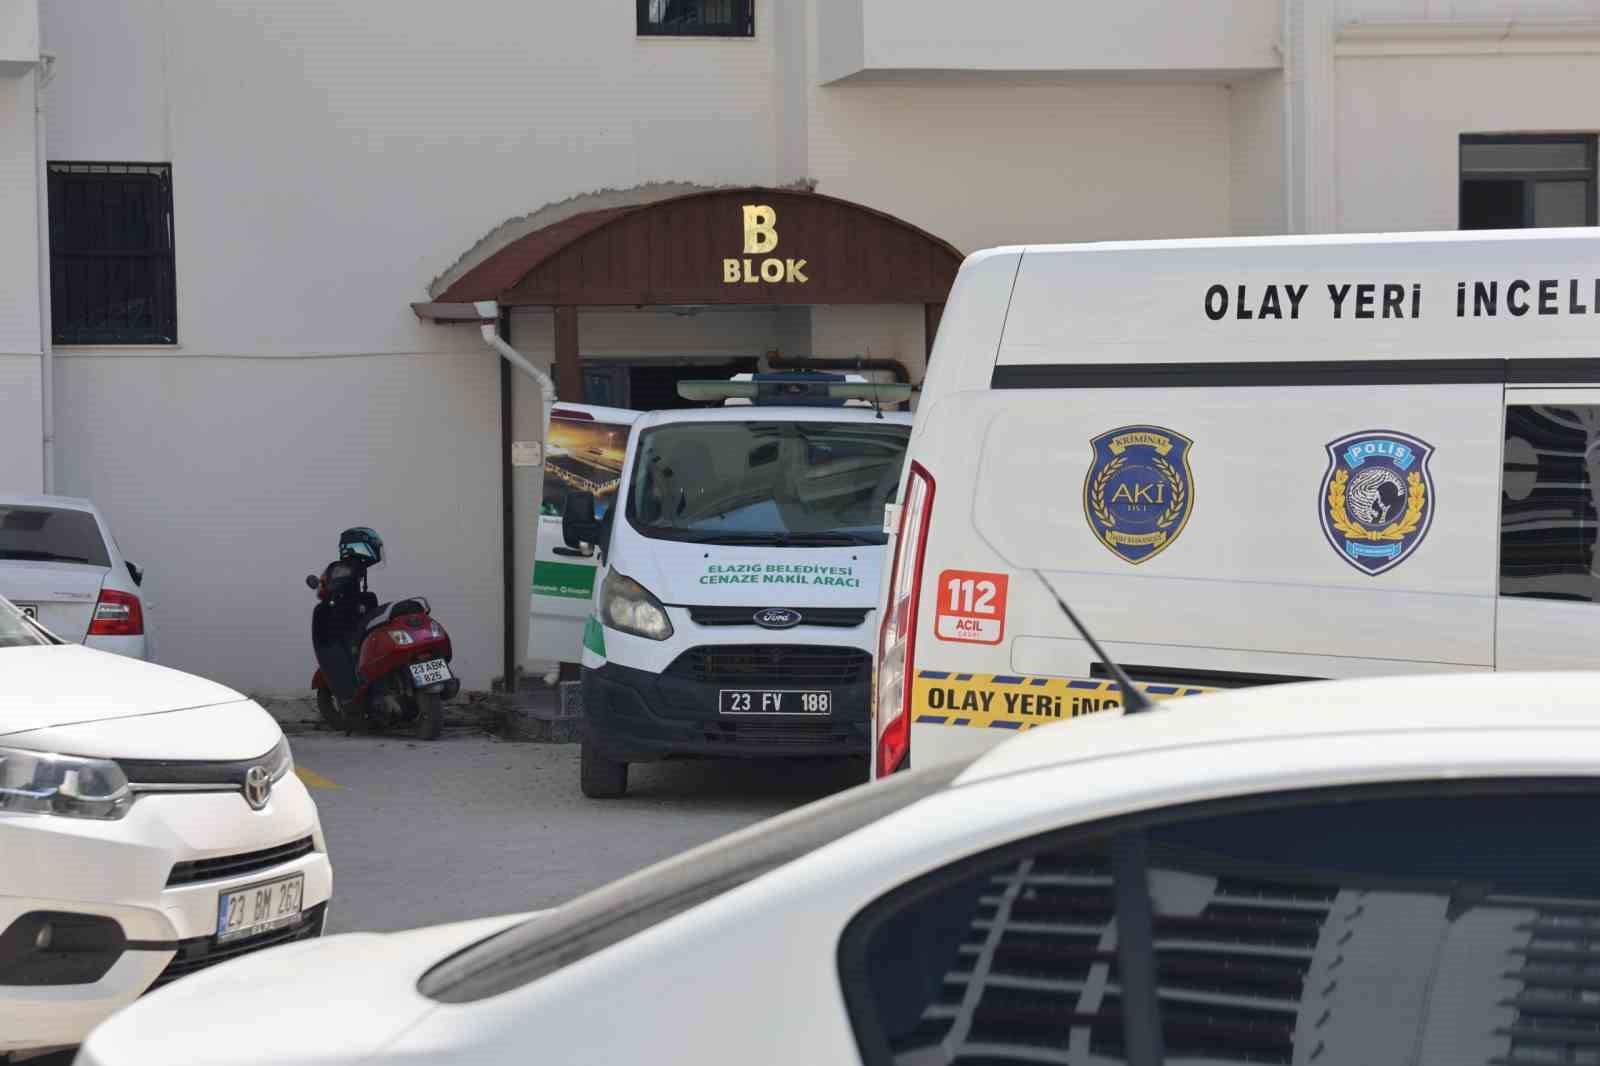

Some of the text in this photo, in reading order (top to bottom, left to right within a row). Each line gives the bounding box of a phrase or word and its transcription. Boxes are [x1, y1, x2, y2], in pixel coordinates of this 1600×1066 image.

[742, 205, 779, 254] B
[723, 258, 809, 283] BLOK
[1204, 283, 1309, 321] OLAY
[1351, 443, 1405, 458] POLİS
[1111, 481, 1165, 503] AKİ
[699, 574, 759, 585] CENAZE
[813, 576, 860, 588] ARACI
[947, 578, 997, 614] 112
[730, 693, 829, 712] 23 FV 188
[927, 687, 994, 715] OLAY
[228, 880, 300, 927] 23 BM 262
